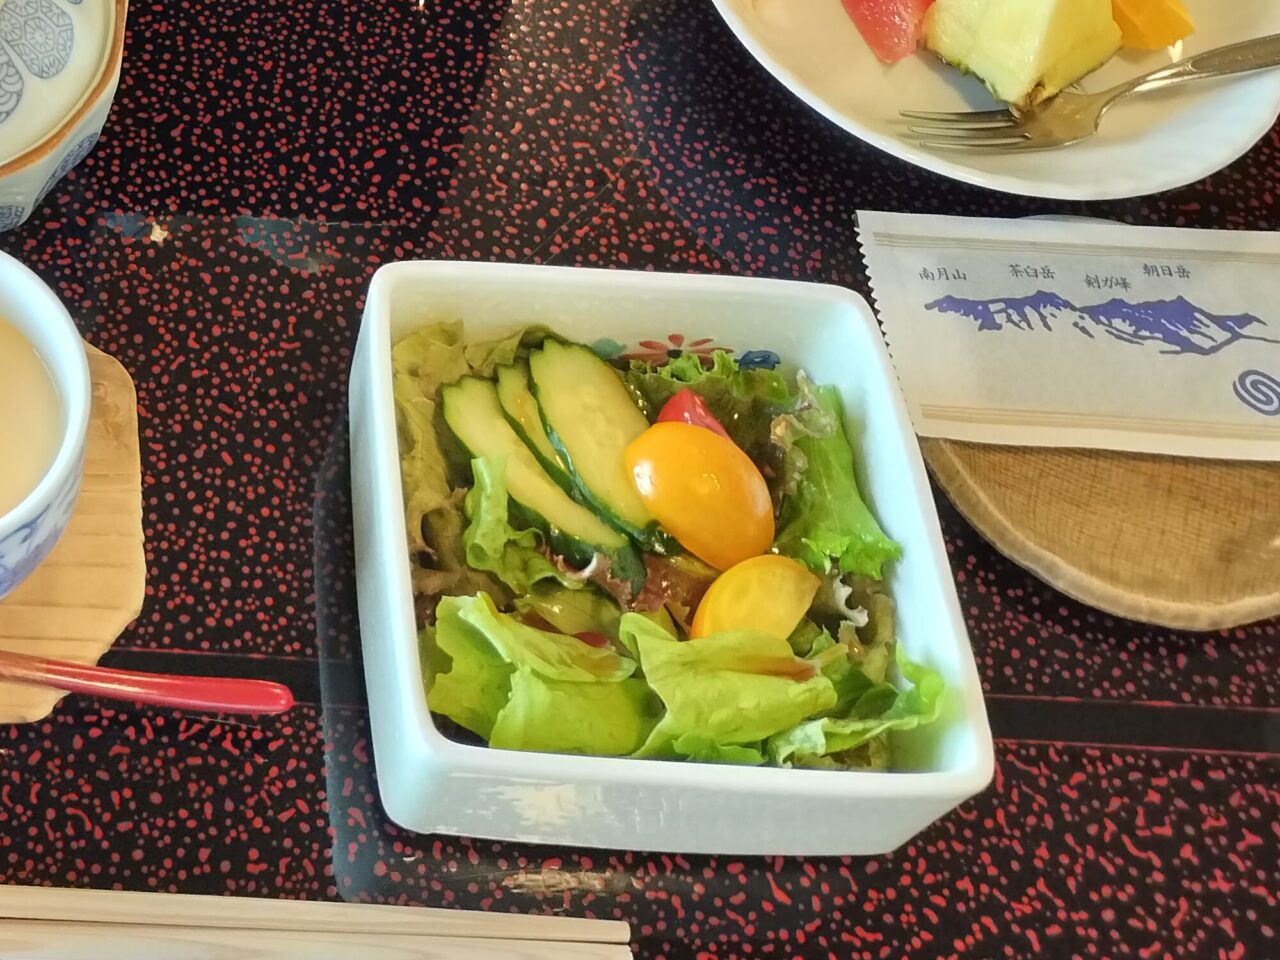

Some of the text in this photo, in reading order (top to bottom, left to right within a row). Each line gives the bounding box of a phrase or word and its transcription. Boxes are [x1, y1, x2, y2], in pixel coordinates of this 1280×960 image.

[919, 266, 968, 282] 南月山
[1008, 263, 1056, 280] 茶臼岳
[1143, 262, 1191, 280] 朝日岳
